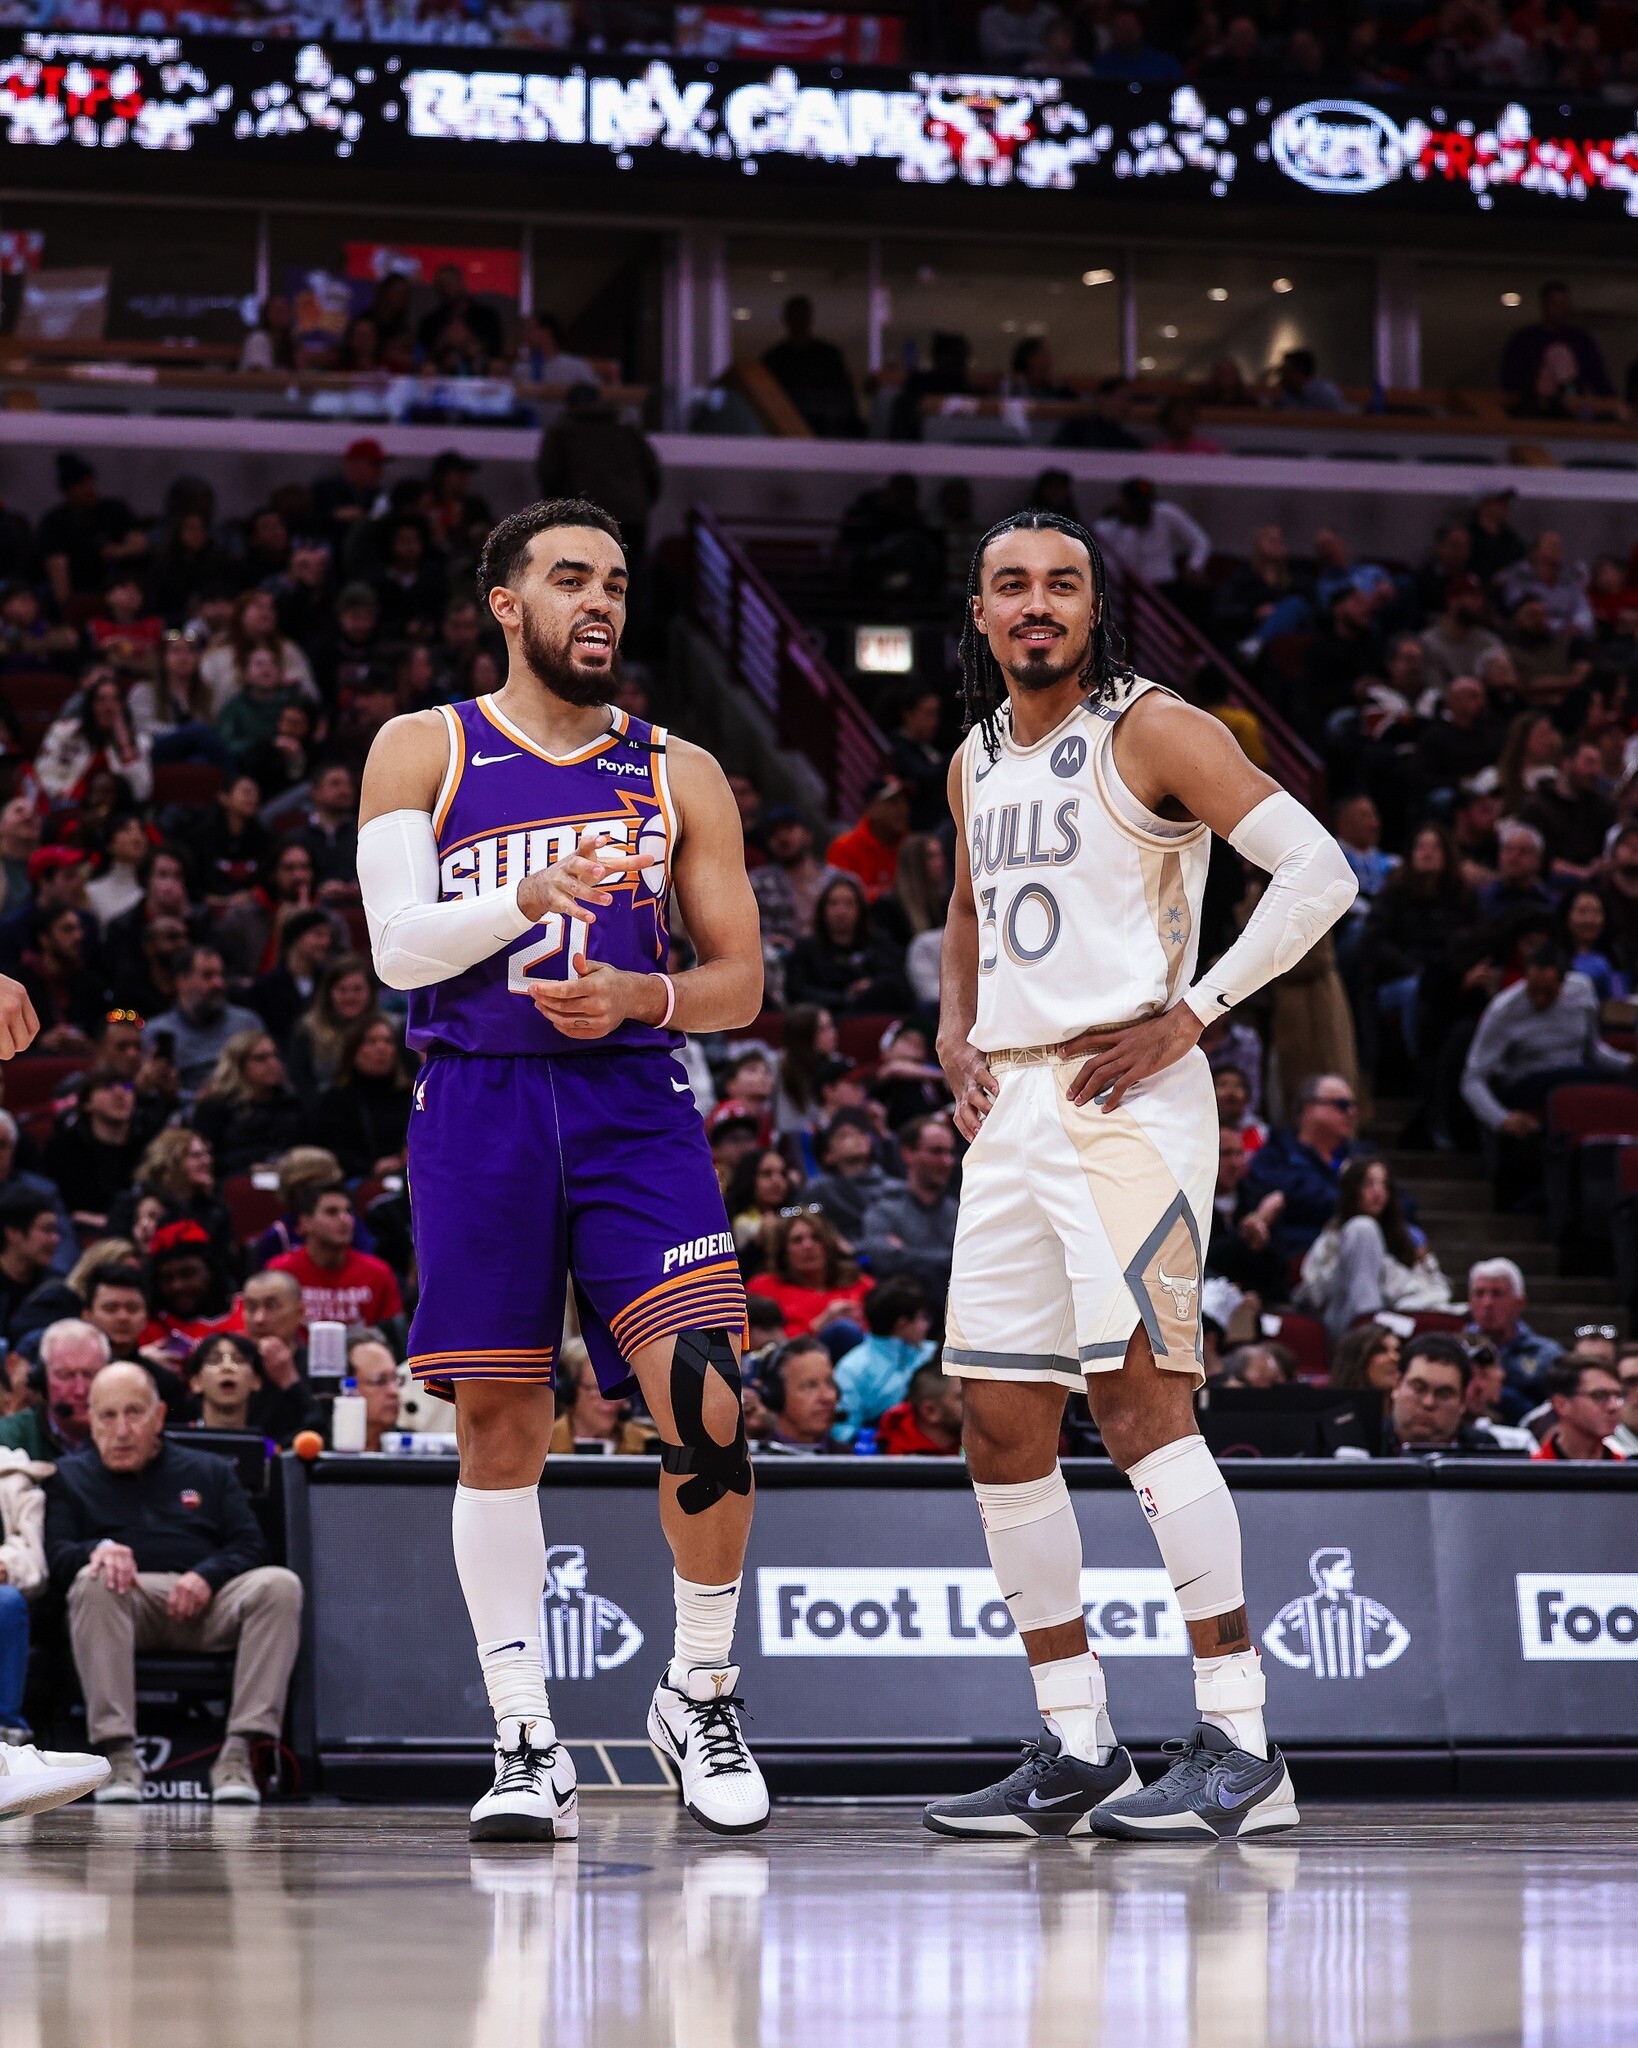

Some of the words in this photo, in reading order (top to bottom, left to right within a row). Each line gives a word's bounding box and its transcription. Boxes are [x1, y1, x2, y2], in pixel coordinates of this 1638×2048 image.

[597, 758, 649, 777] PayPal
[628, 740, 640, 749] AL
[440, 818, 630, 900] SUNS
[972, 798, 1082, 882] BULLS
[508, 912, 590, 995] 21
[979, 882, 1062, 977] 30
[779, 1585, 922, 1639] Foot
[947, 1585, 1166, 1638] Loker
[1537, 1591, 1638, 1643] Foo
